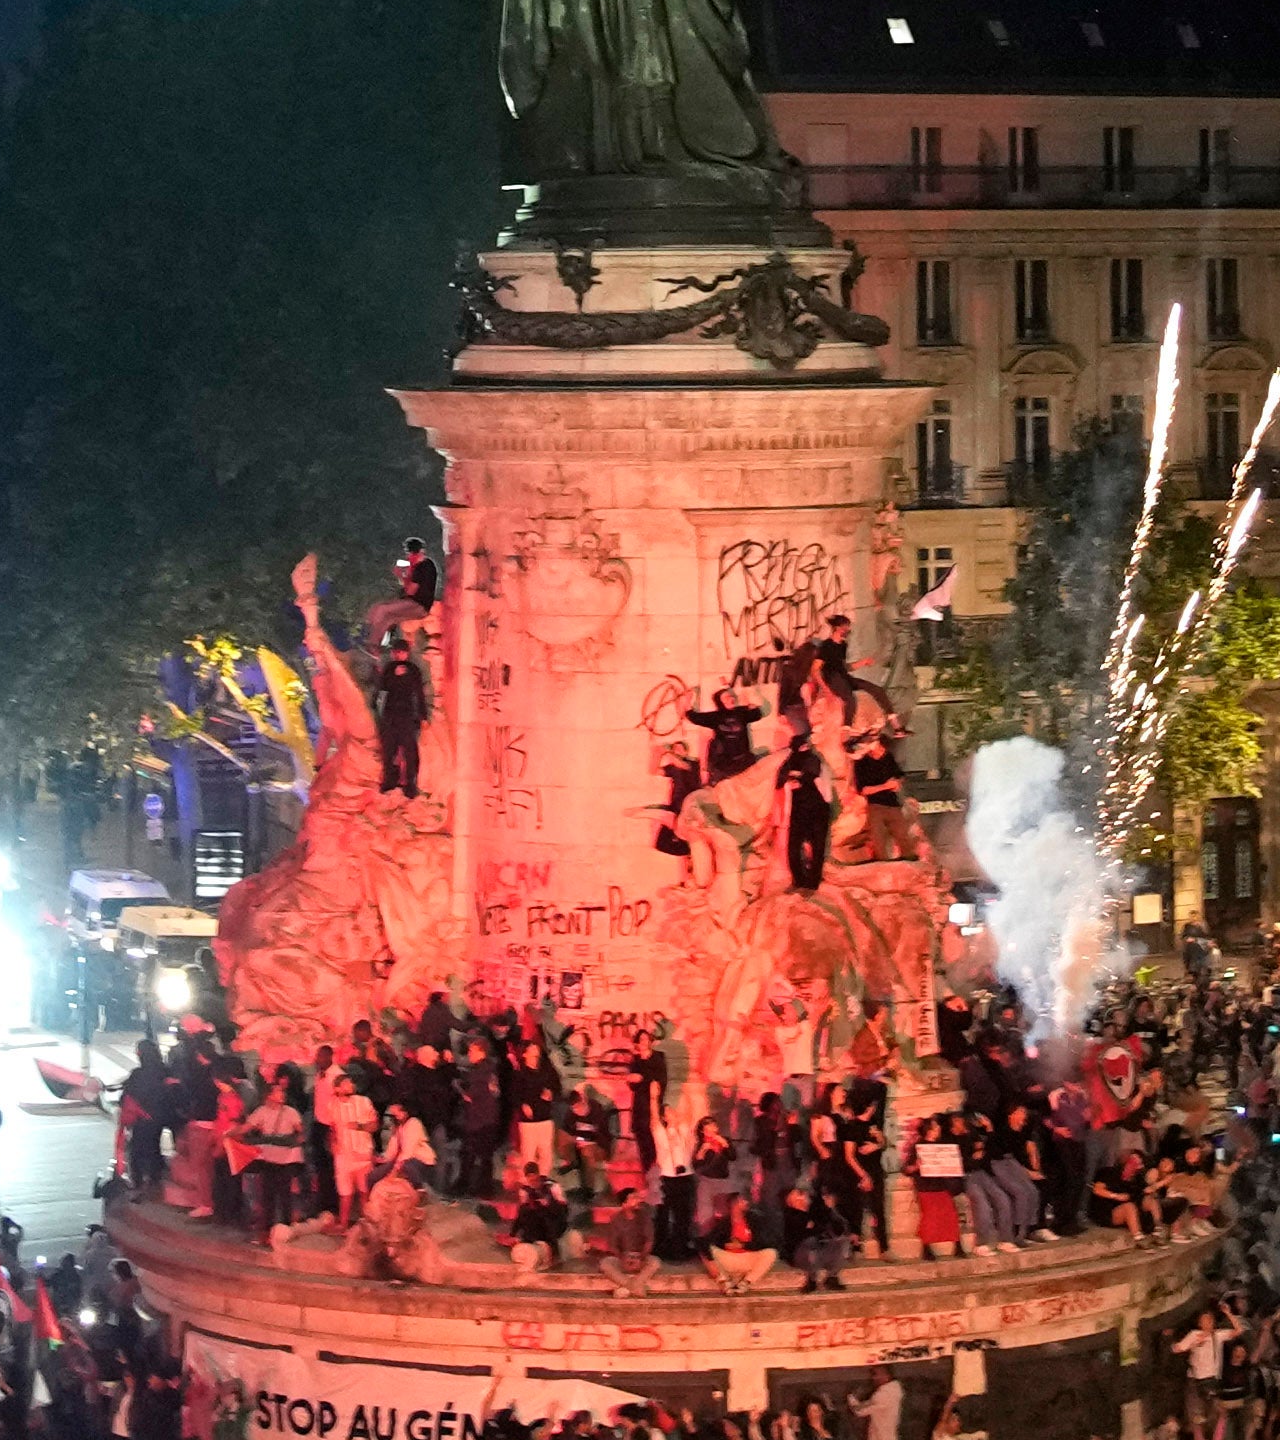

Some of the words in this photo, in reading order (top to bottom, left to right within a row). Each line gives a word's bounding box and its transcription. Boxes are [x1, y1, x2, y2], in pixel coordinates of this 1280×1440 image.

[526, 901, 607, 938] FRONT
[608, 885, 652, 939] POP
[256, 1390, 338, 1439] STOP
